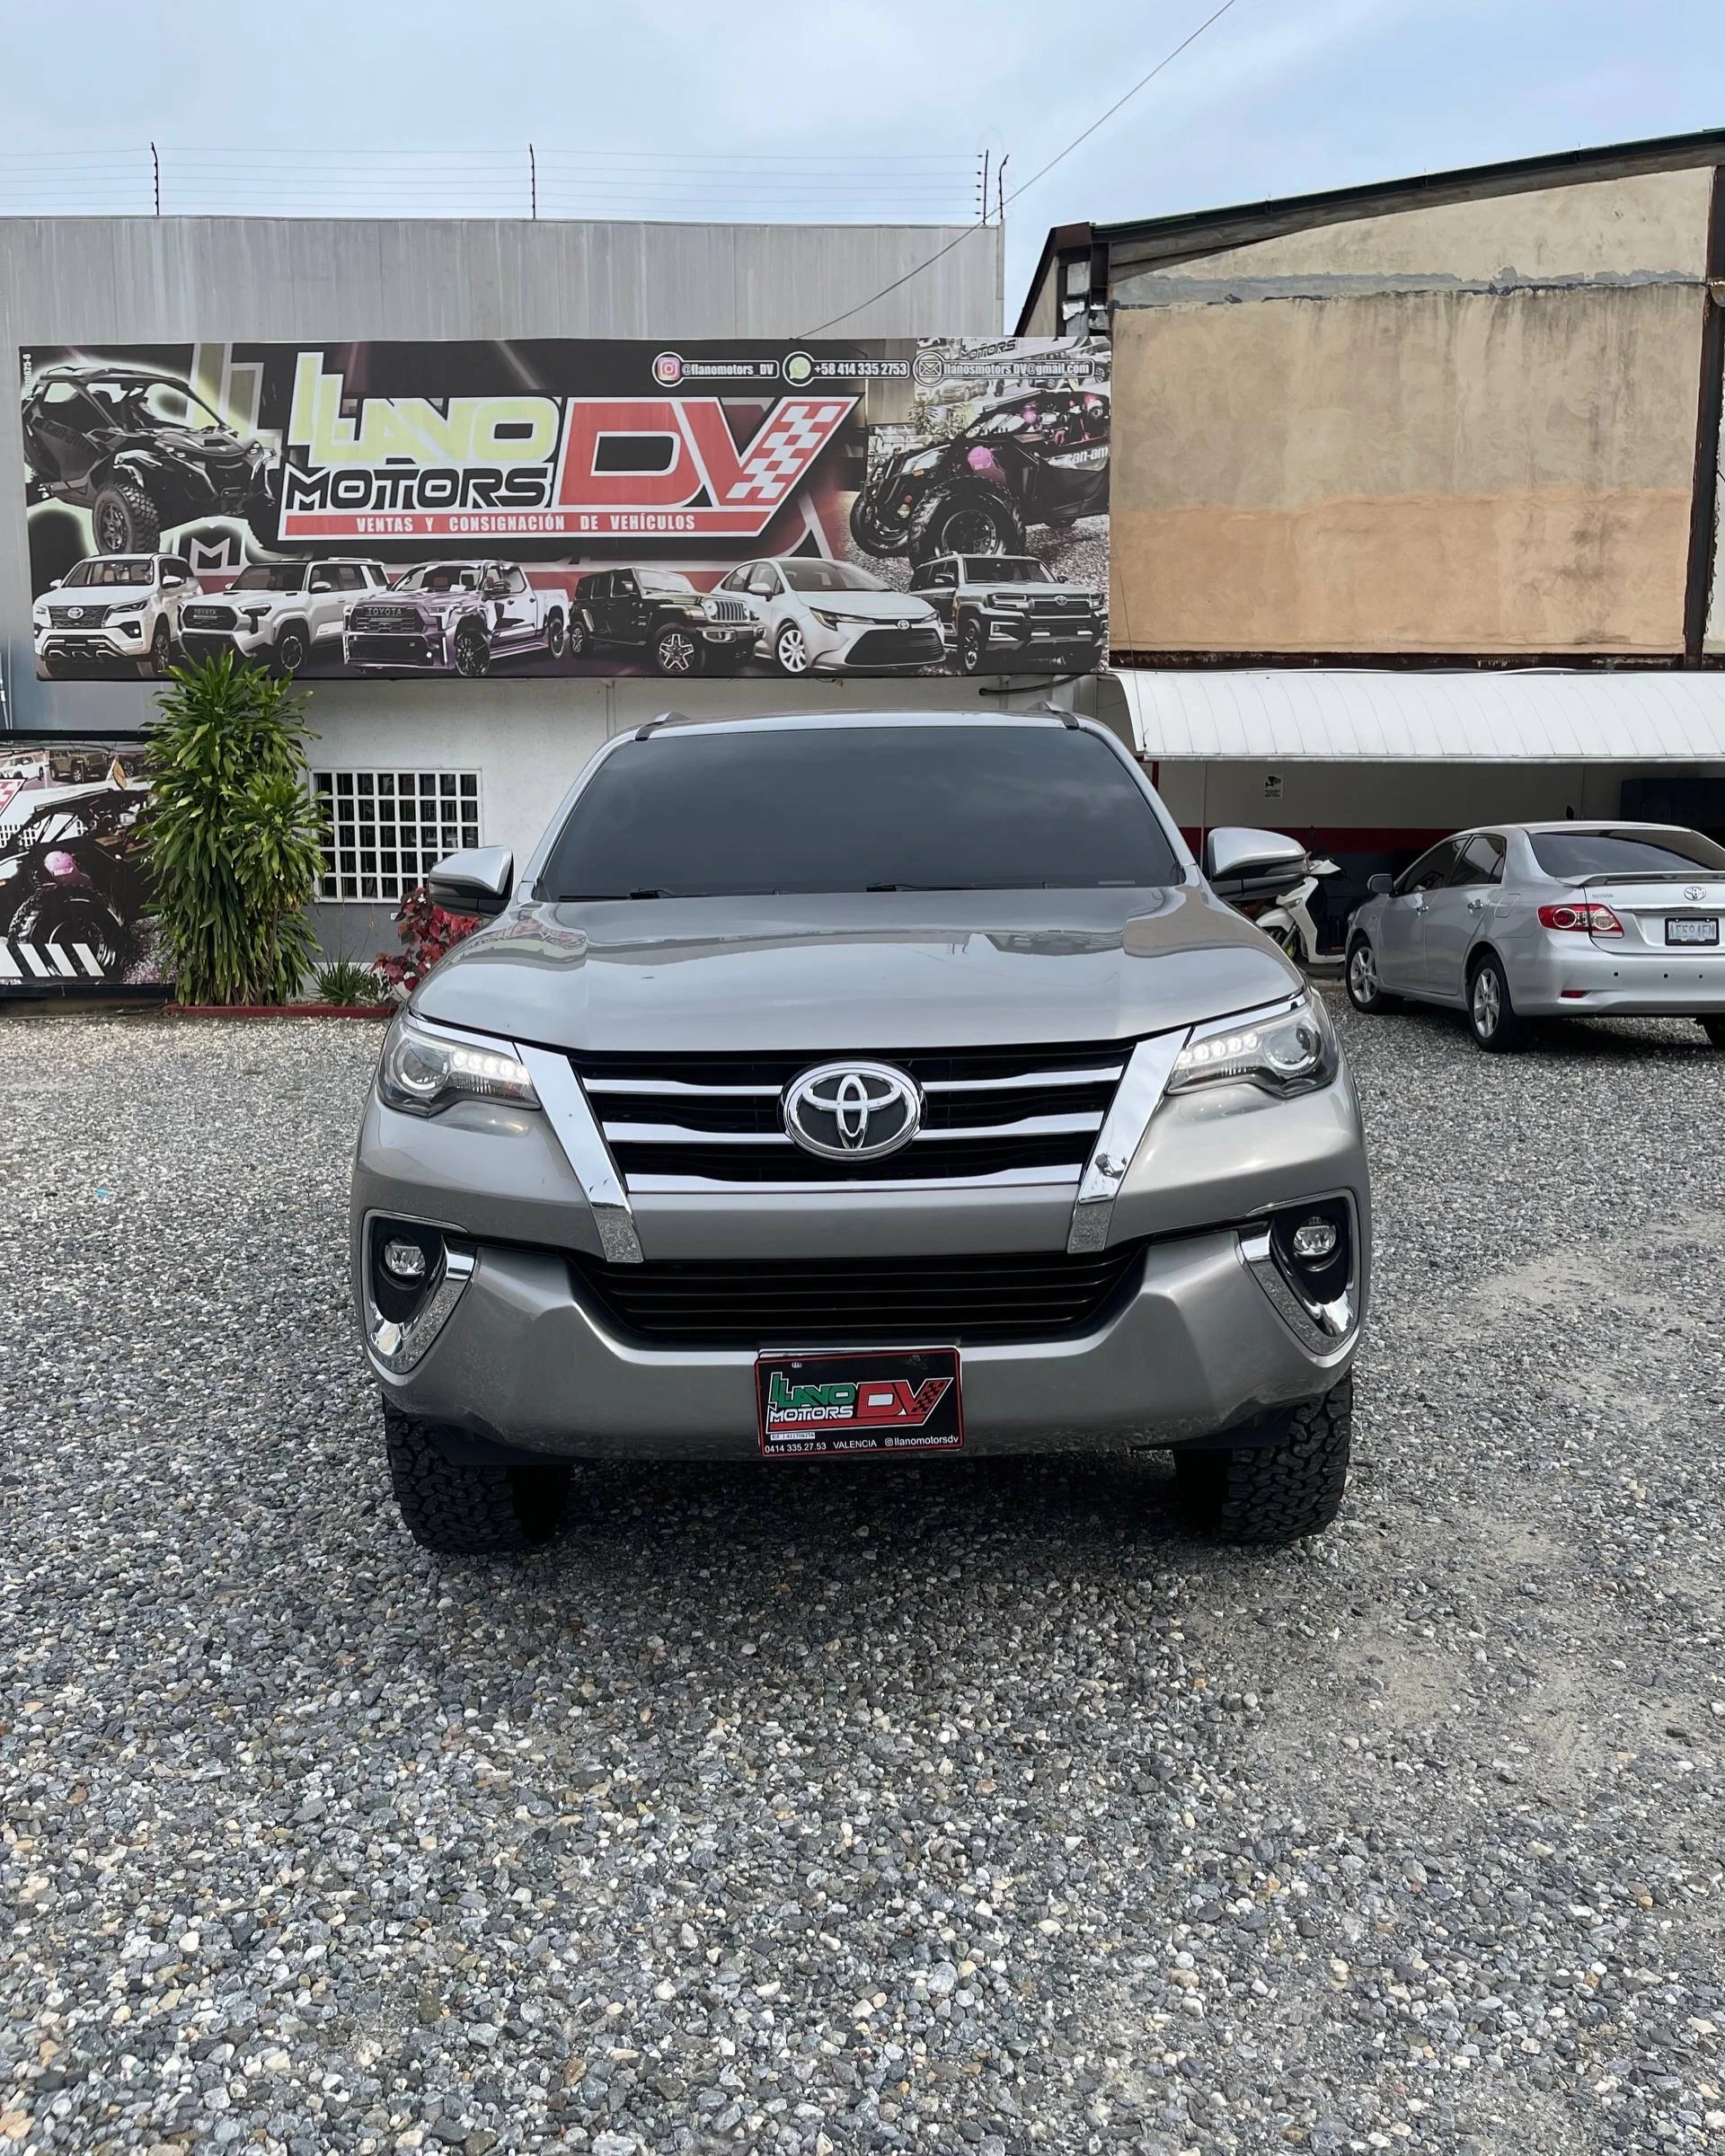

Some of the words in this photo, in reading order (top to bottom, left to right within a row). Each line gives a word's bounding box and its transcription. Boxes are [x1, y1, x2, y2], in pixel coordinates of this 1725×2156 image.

[682, 363, 774, 376] @llanomotors_DV
[814, 363, 836, 376] +58
[837, 363, 856, 376] 414
[857, 363, 879, 376] 335
[880, 363, 907, 376] 2753
[555, 398, 858, 507] DV
[285, 467, 548, 510] MOTORS
[356, 517, 413, 532] VENTAS
[425, 517, 435, 532] Y
[449, 513, 565, 532] CONSIGNACIÓN
[579, 516, 598, 531] DE
[610, 512, 695, 531] VEHÍCULOS
[367, 608, 402, 616] TOYOTA
[856, 1379, 952, 1418] DV
[770, 1406, 854, 1423] MOTORS
[765, 1445, 784, 1454] 0414
[787, 1442, 827, 1453] 335.27.53
[833, 1439, 877, 1450] VALENCIA
